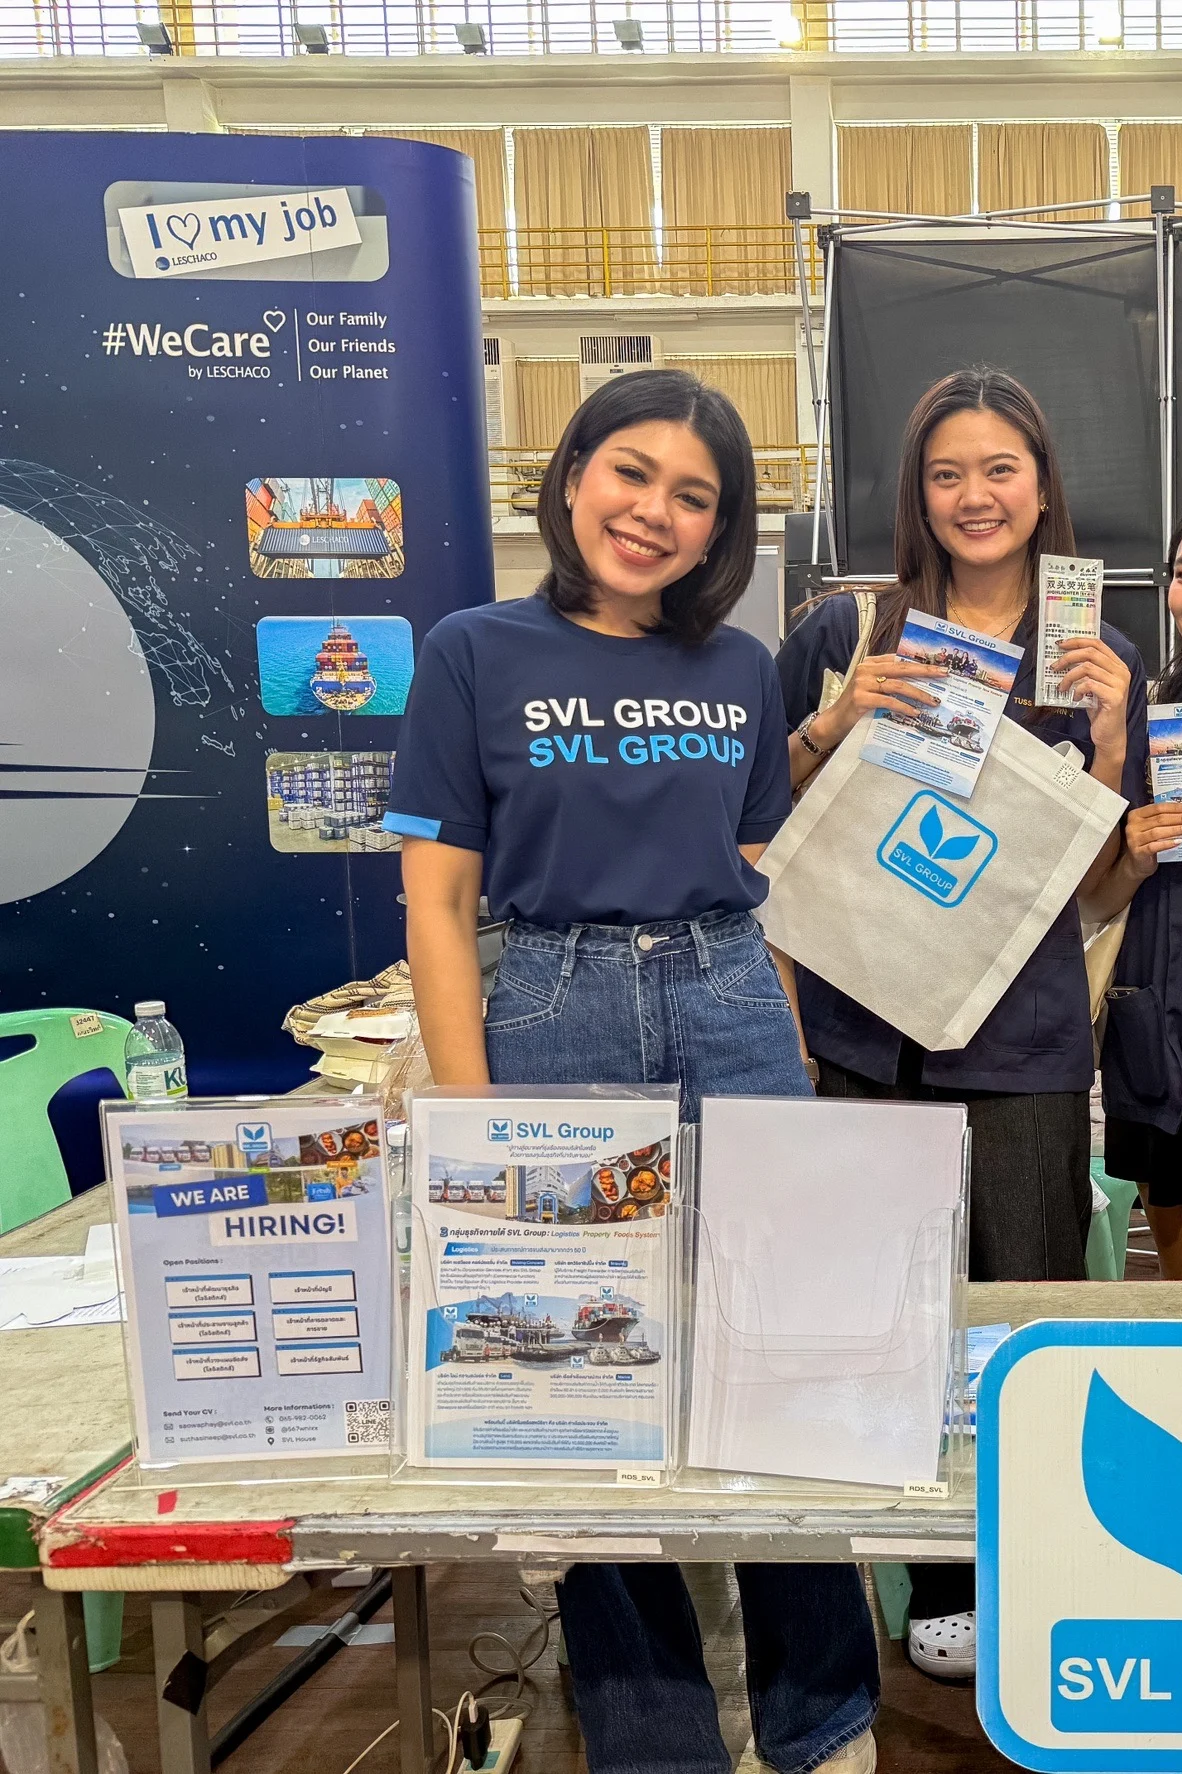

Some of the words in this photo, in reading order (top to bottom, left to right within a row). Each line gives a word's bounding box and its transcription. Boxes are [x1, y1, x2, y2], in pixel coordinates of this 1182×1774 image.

[146, 213, 162, 249] I
[208, 211, 267, 245] my
[281, 197, 337, 241] job
[172, 252, 217, 266] LESCHACO
[306, 312, 334, 326] Our
[339, 312, 387, 328] Family
[102, 323, 270, 358] #WeCare
[308, 339, 337, 353] Our
[341, 338, 396, 353] Friends
[188, 366, 203, 379] by
[207, 366, 270, 379] LESCHACO
[310, 365, 338, 380] Our
[343, 365, 388, 380] Planet
[1047, 580, 1096, 591] 双头荧光笔
[948, 627, 967, 639] SVL
[968, 634, 997, 649] Group
[524, 698, 605, 732] SVL
[614, 699, 747, 731] GROUP
[529, 734, 609, 767] SVL
[618, 733, 745, 767] GROUP
[893, 848, 912, 867] SVL
[915, 863, 953, 891] GROUP
[516, 1122, 553, 1138] SVL
[558, 1123, 614, 1142] Group
[171, 1188, 206, 1208] WE
[210, 1185, 250, 1204] ARE
[225, 1213, 345, 1238] HIRING!
[440, 1227, 449, 1237] 3
[551, 1230, 580, 1238] Logistics
[582, 1231, 611, 1239] Property
[451, 1246, 479, 1254] Logistics
[163, 1259, 184, 1267] Open
[185, 1257, 219, 1265] Positions
[1058, 1657, 1171, 1701] SVL
